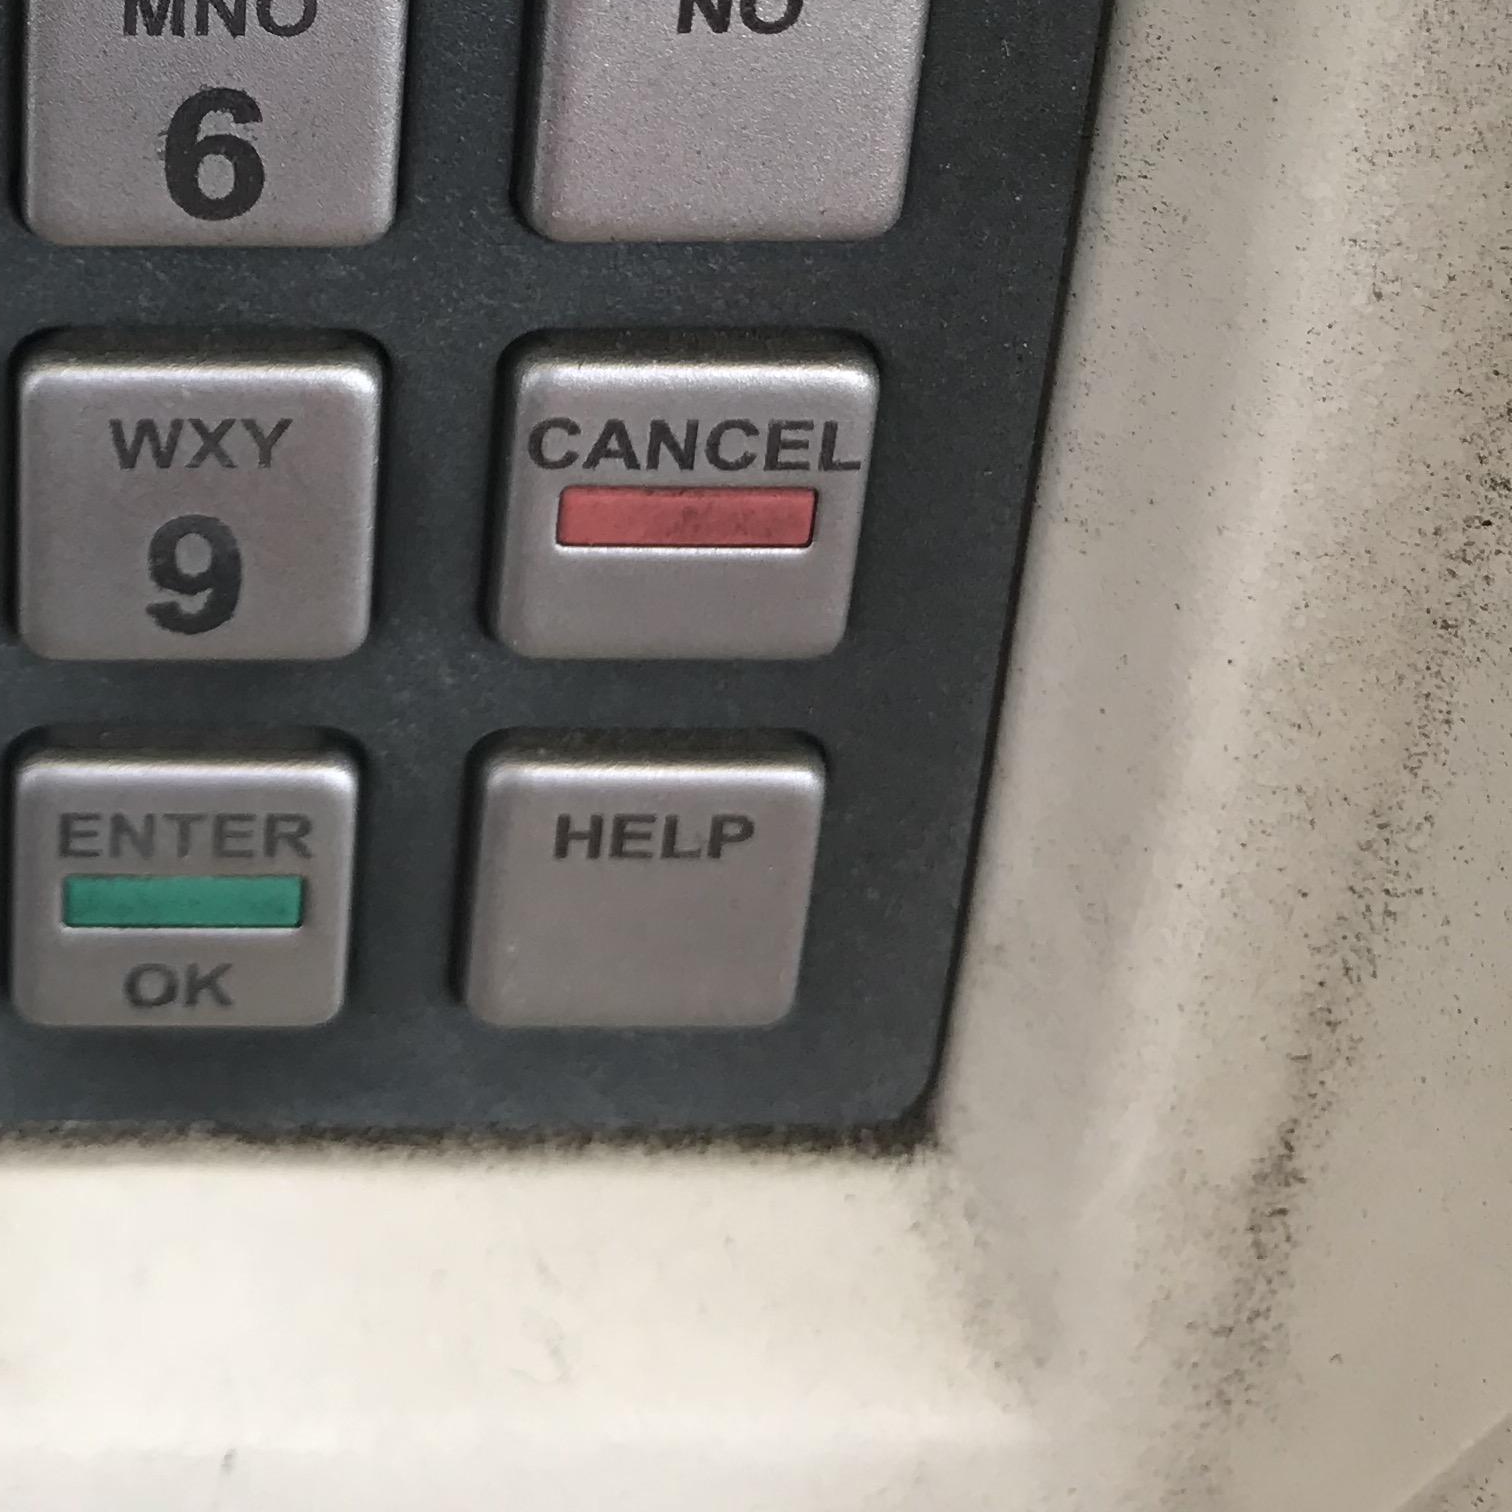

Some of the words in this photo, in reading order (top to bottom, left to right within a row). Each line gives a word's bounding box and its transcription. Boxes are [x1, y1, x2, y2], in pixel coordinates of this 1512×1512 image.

[159, 85, 265, 221] 6
[109, 418, 293, 470] WXY
[526, 418, 861, 472] CANCEL
[146, 515, 242, 635] 9
[58, 813, 313, 860] ENTER
[553, 814, 755, 860] HELP
[124, 964, 233, 1010] OK
